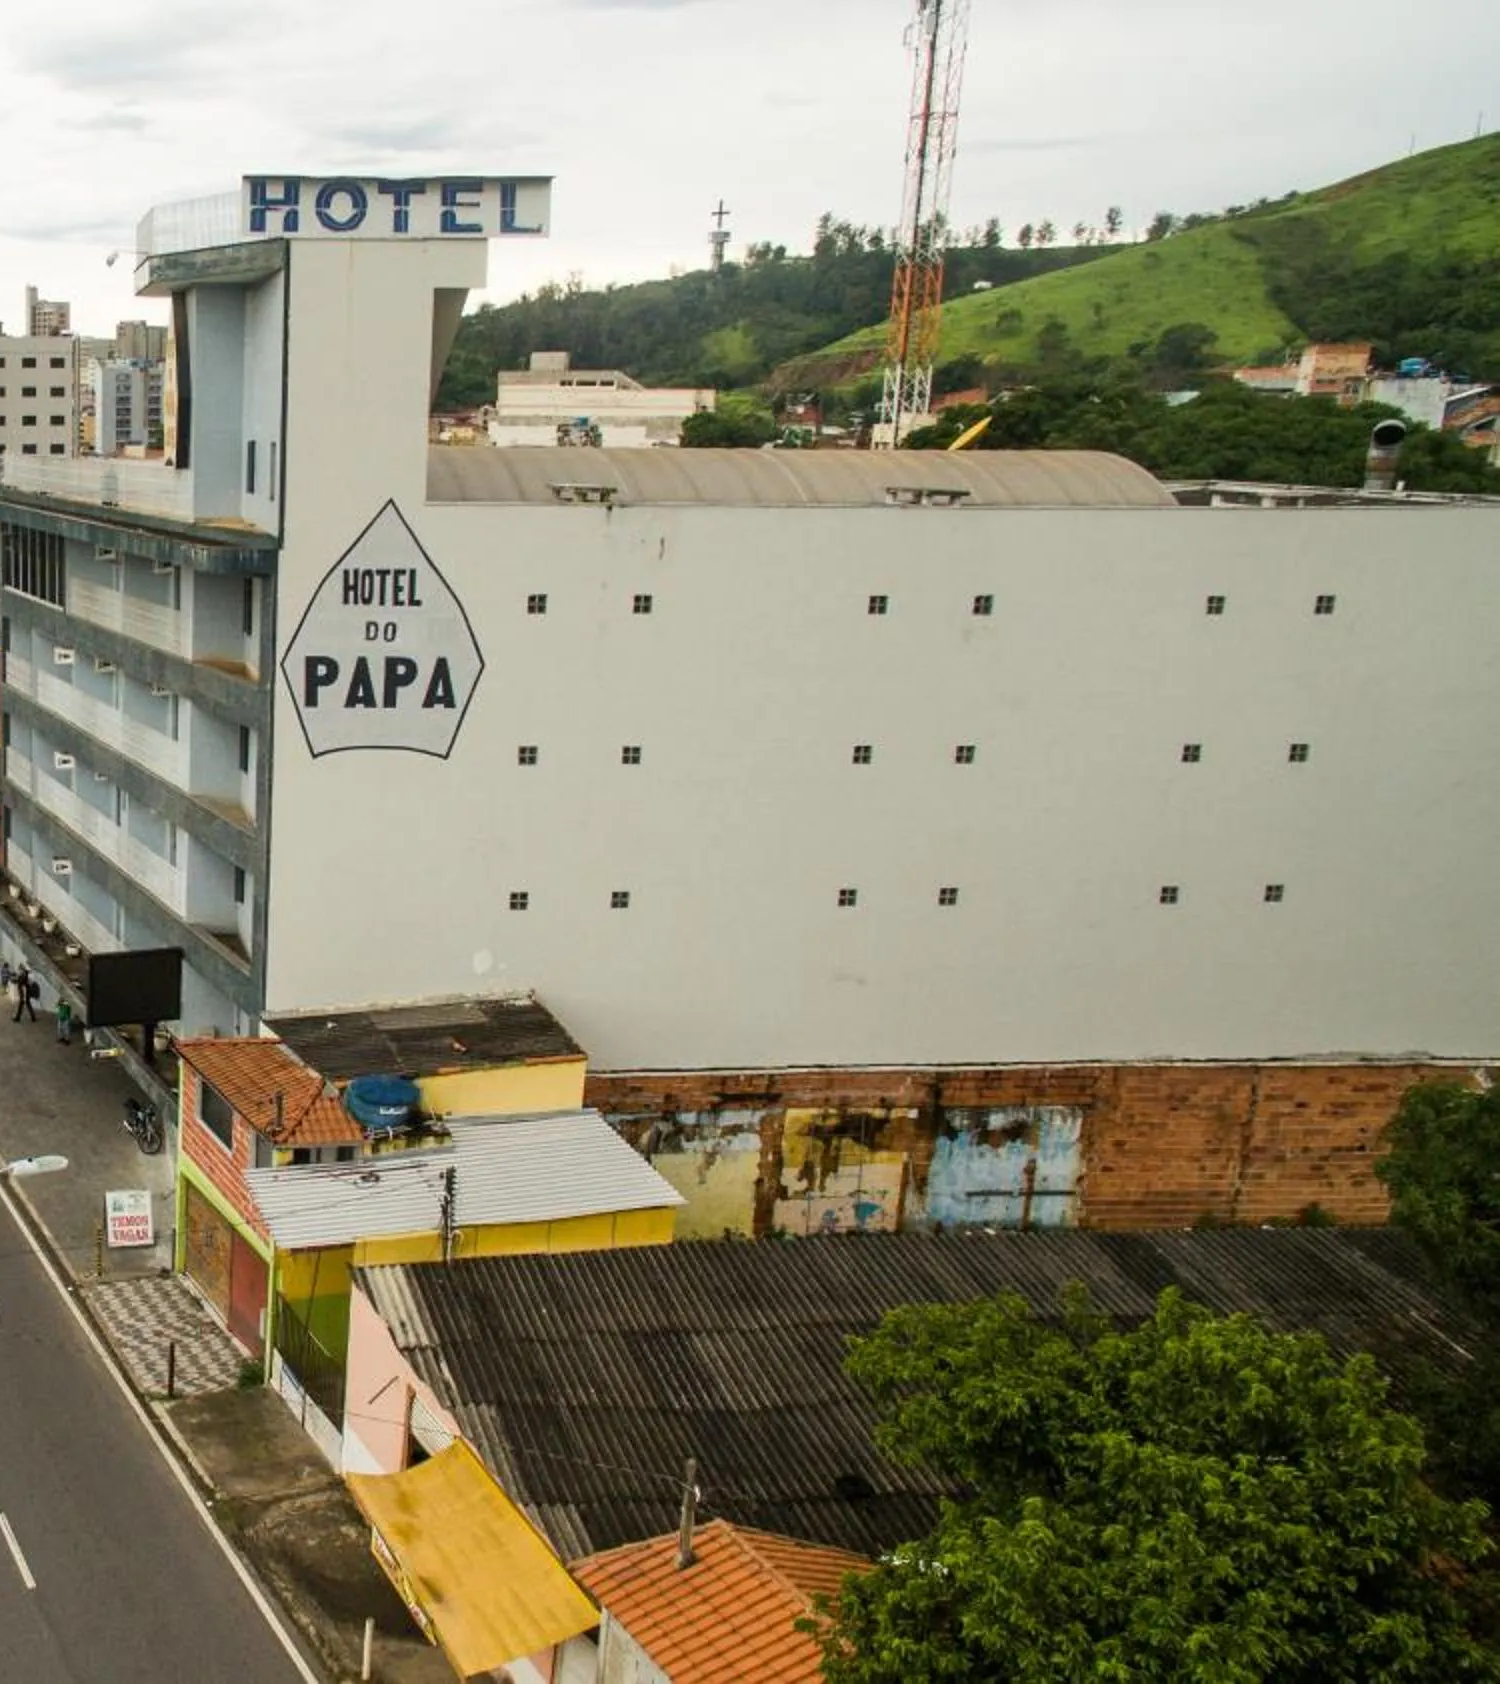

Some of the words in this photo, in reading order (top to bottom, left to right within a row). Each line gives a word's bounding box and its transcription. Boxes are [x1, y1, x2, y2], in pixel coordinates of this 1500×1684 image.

[249, 179, 544, 233] HOTEL
[343, 567, 423, 607] HOTEL
[365, 620, 397, 643] DO
[304, 655, 456, 709] PAPA
[111, 1215, 149, 1229] TEMOS
[112, 1228, 149, 1242] VAGAS
